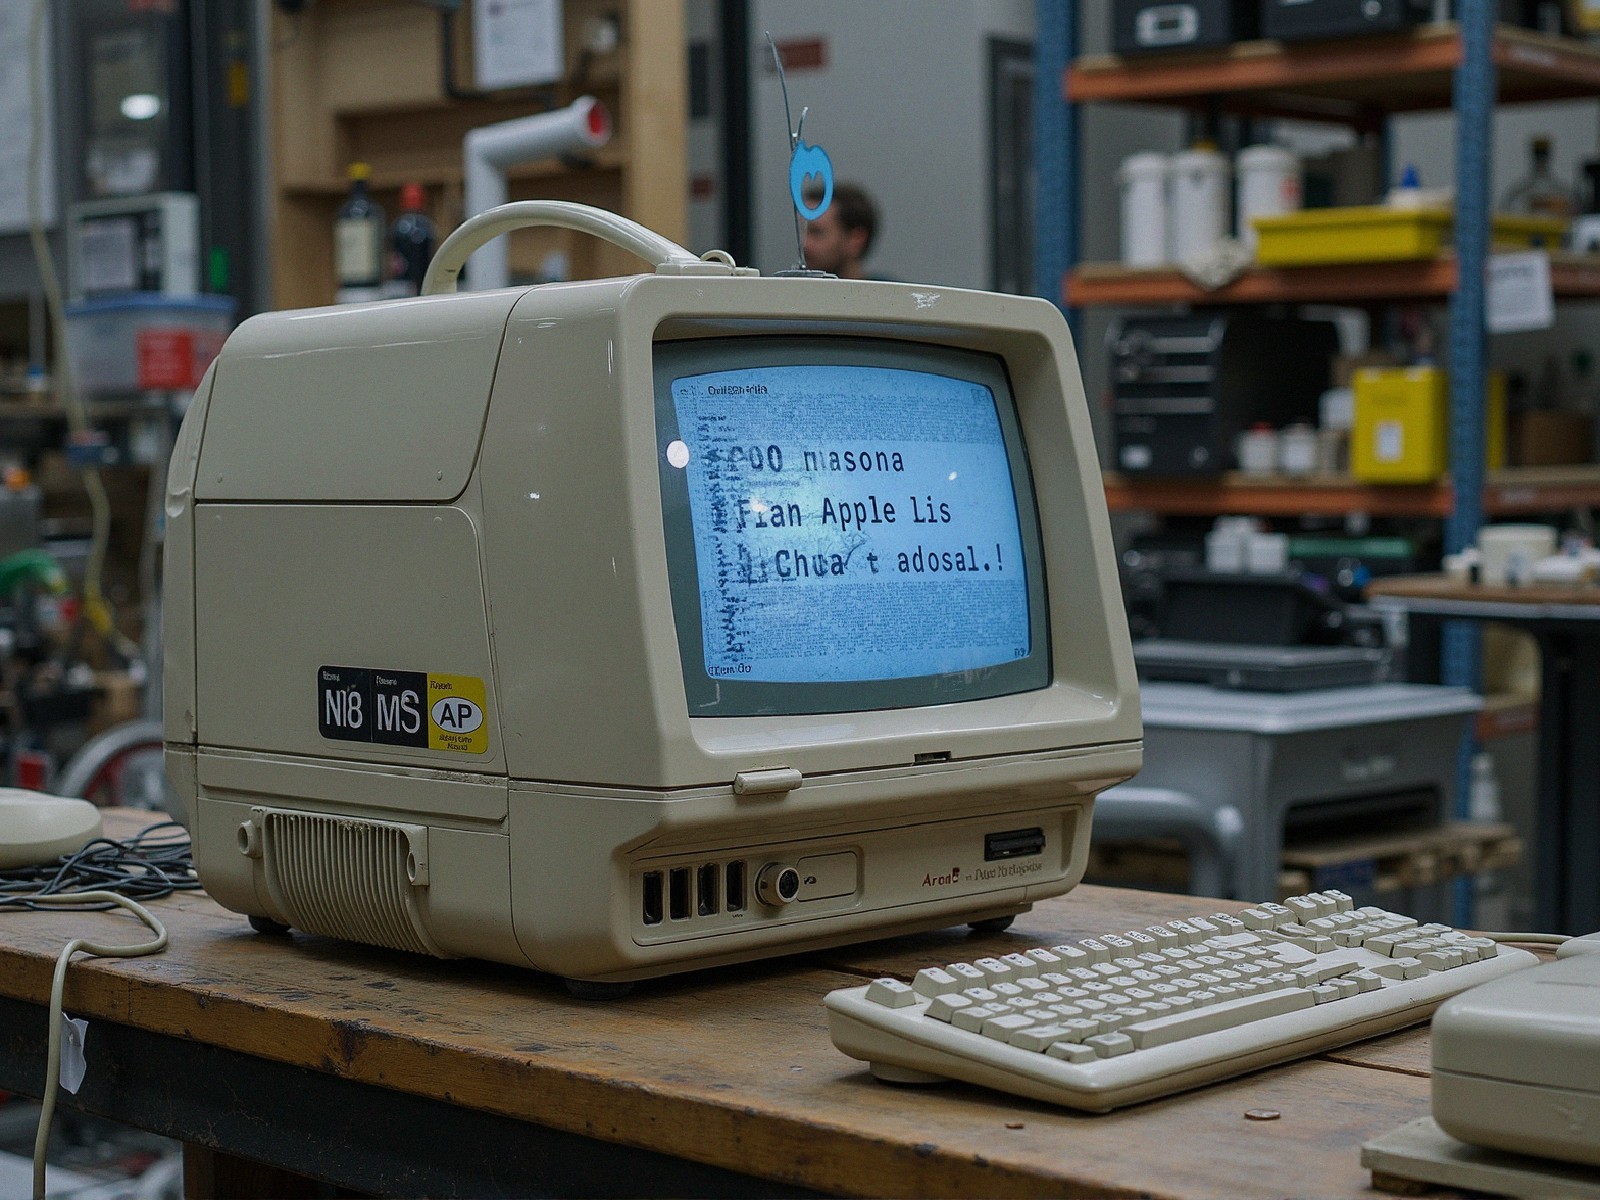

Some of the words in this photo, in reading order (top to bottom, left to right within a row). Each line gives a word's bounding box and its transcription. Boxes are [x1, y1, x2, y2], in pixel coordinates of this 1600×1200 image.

[822, 495, 896, 532] Apple
[377, 689, 421, 734] MS
[439, 702, 473, 729] AP
